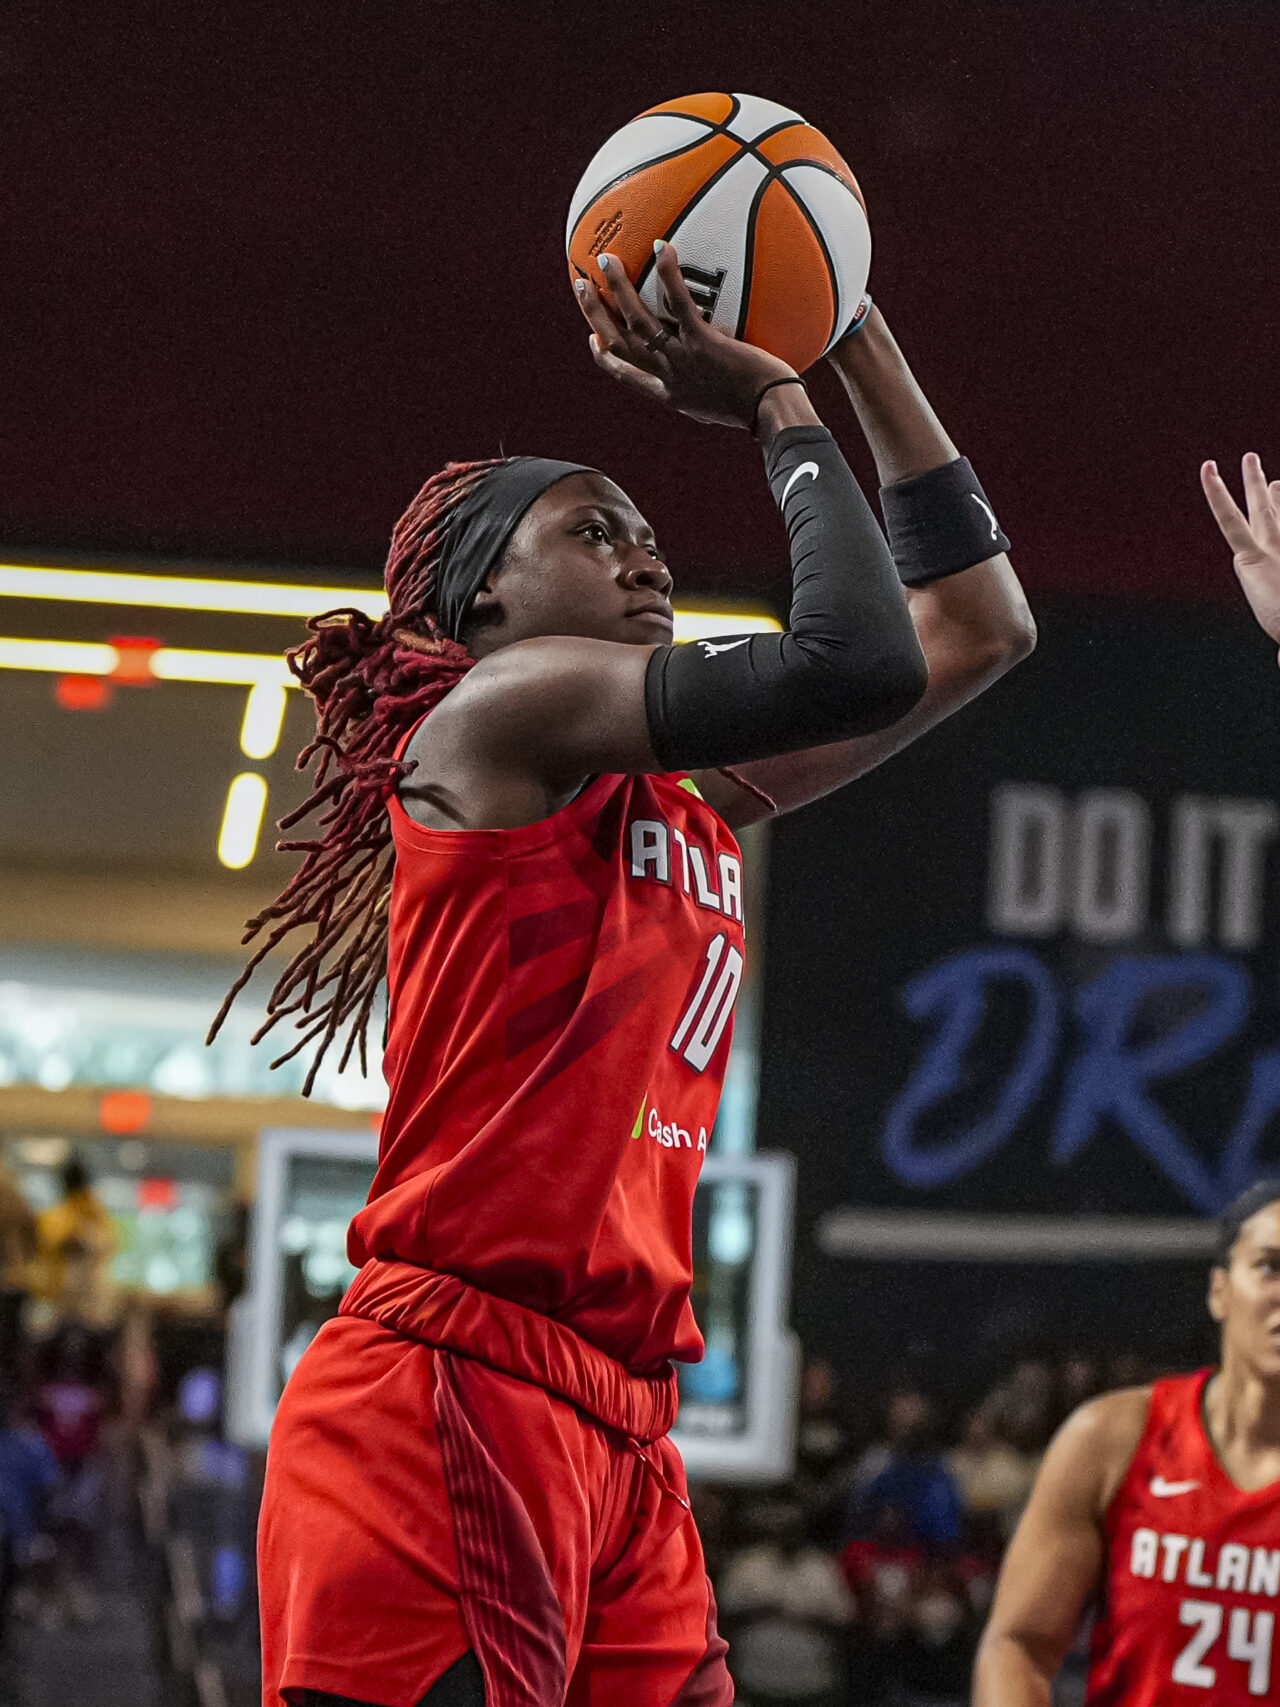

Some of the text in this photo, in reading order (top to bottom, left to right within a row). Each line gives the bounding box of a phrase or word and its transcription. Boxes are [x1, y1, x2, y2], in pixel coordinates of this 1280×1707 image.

[631, 820, 745, 928] ATLA
[988, 785, 1146, 938] DO
[1169, 797, 1279, 948] IT
[671, 933, 743, 1072] 10
[648, 1107, 693, 1148] Cash
[1172, 1599, 1275, 1696] 24
